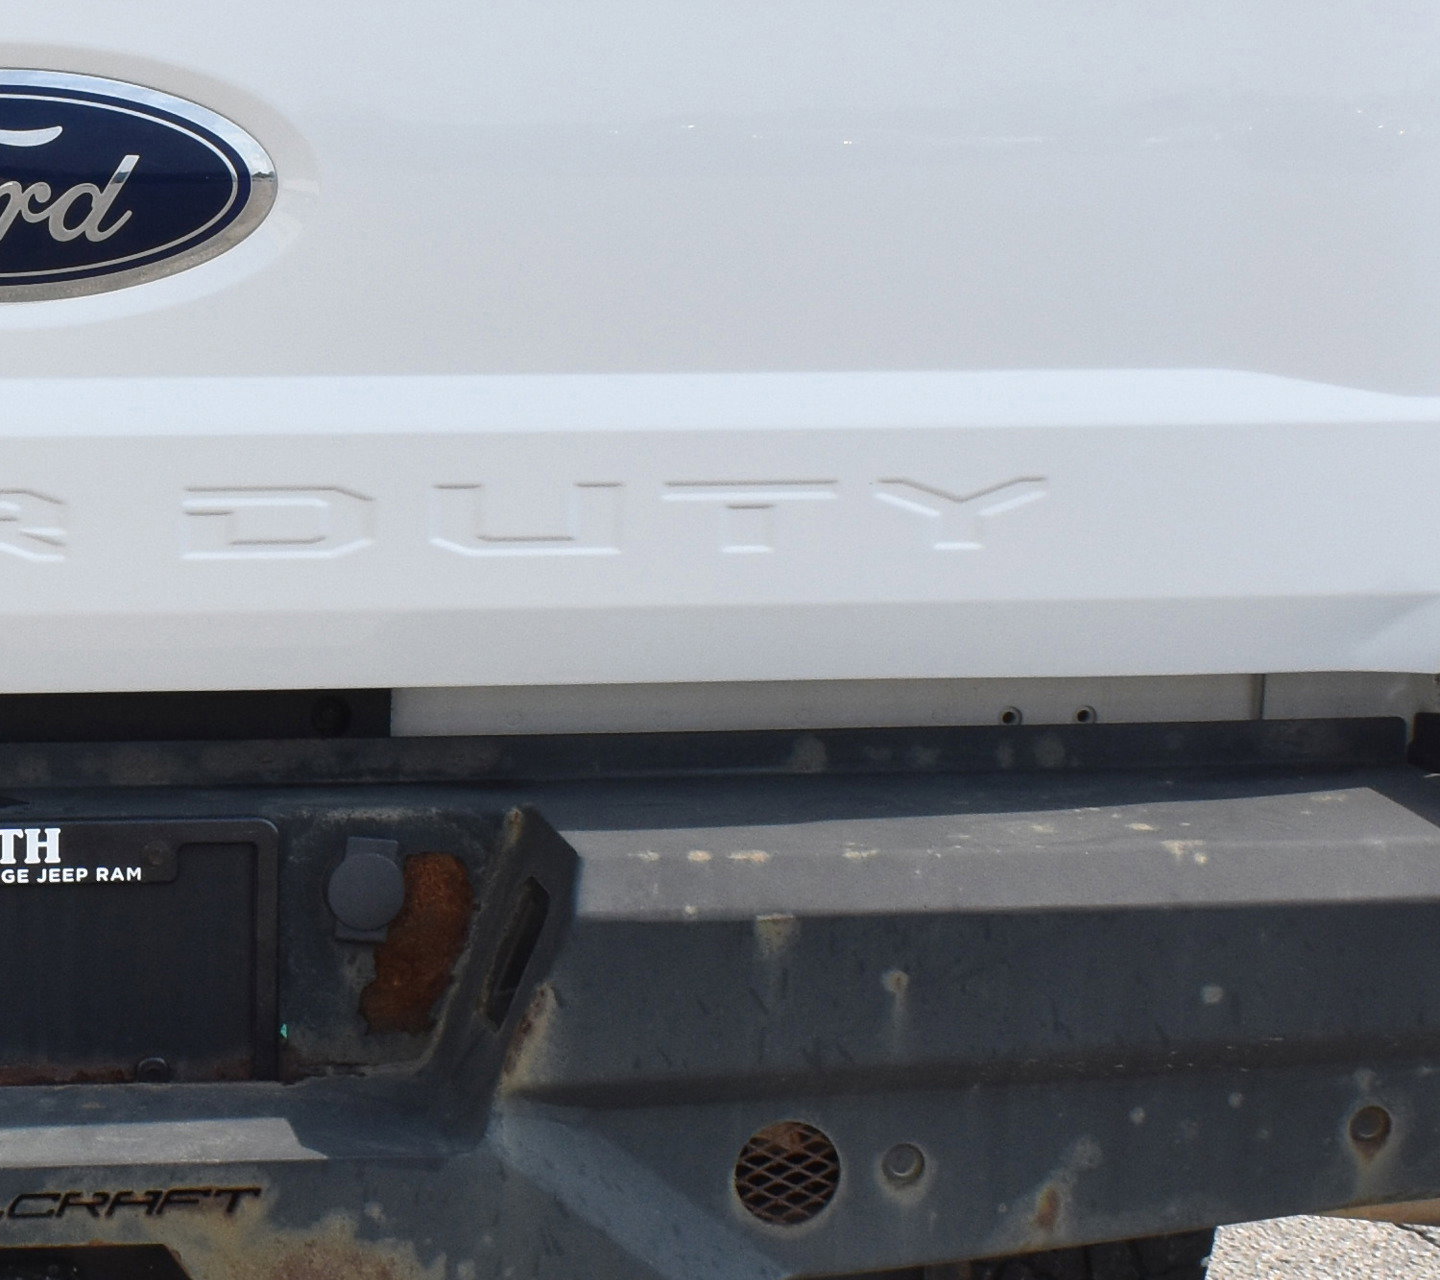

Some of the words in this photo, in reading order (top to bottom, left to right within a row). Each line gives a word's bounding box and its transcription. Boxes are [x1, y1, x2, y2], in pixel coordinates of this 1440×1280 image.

[180, 477, 1051, 564] DUTY
[36, 867, 89, 884] JEEP
[95, 866, 143, 883] RAM
